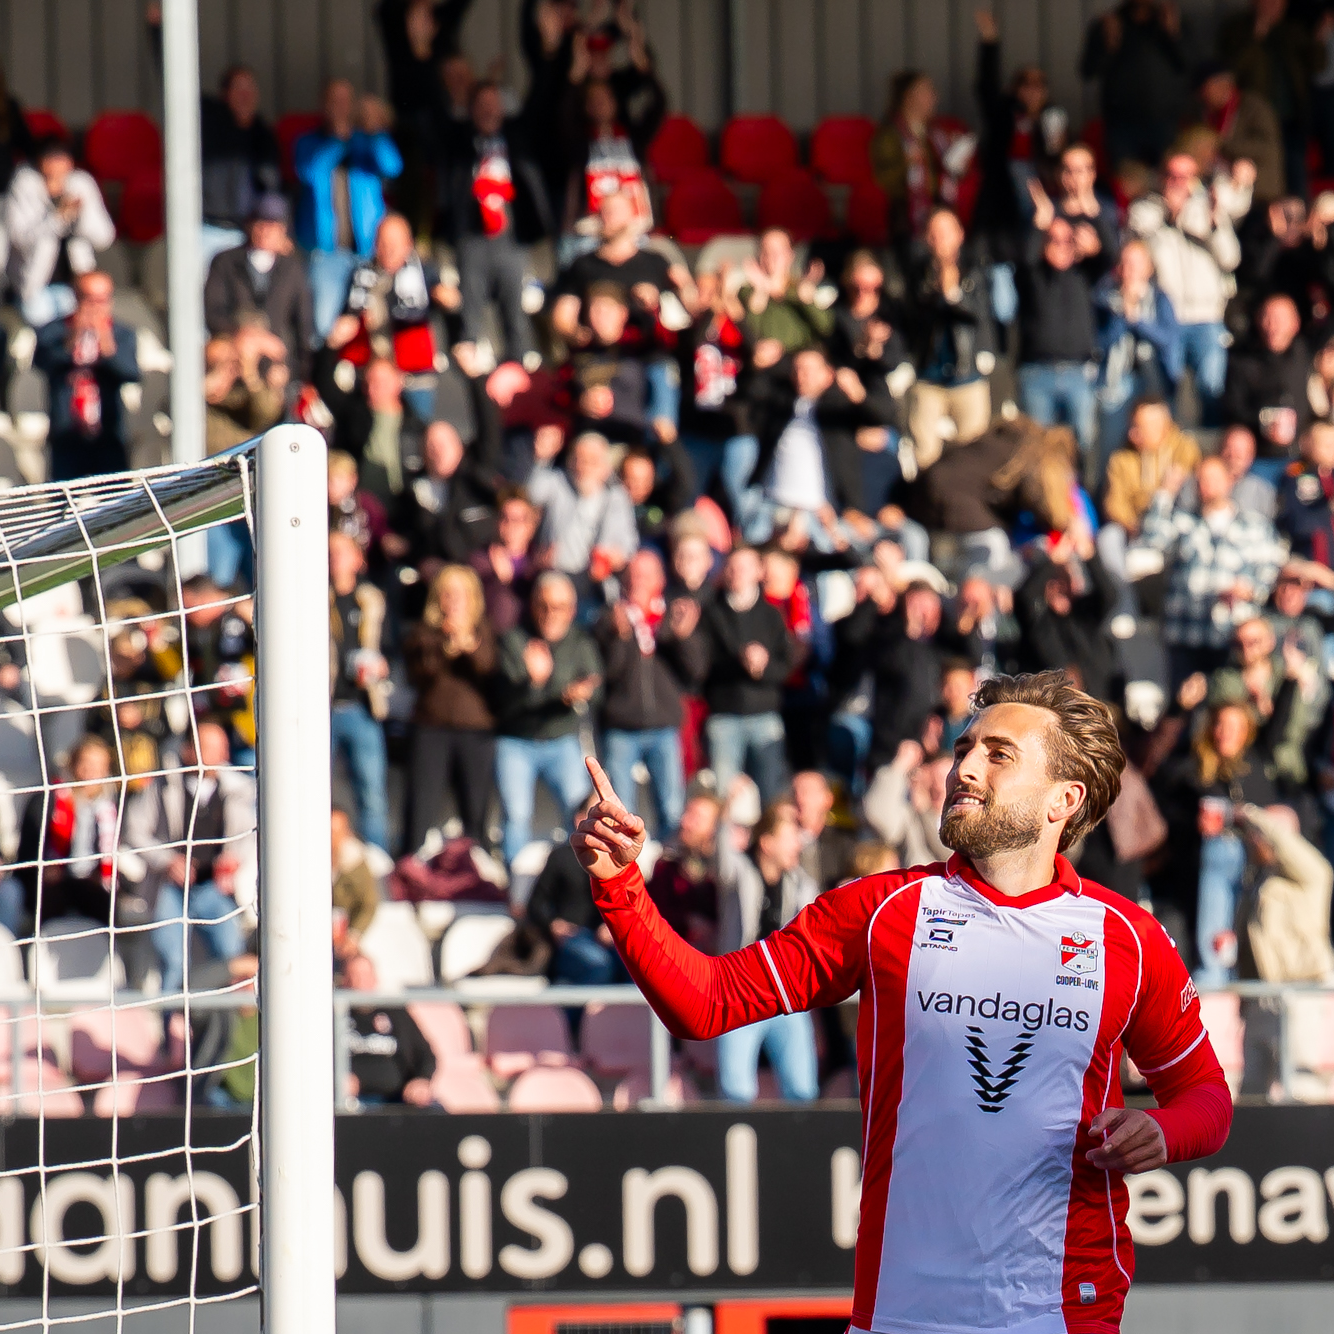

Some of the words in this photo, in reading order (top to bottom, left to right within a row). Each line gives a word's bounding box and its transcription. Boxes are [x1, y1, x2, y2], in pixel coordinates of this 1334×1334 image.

[920, 943, 958, 952] STANNO
[1072, 947, 1095, 955] EMMEN
[1055, 974, 1099, 991] COOPER-LOVE
[917, 990, 1090, 1031] vandaglas
